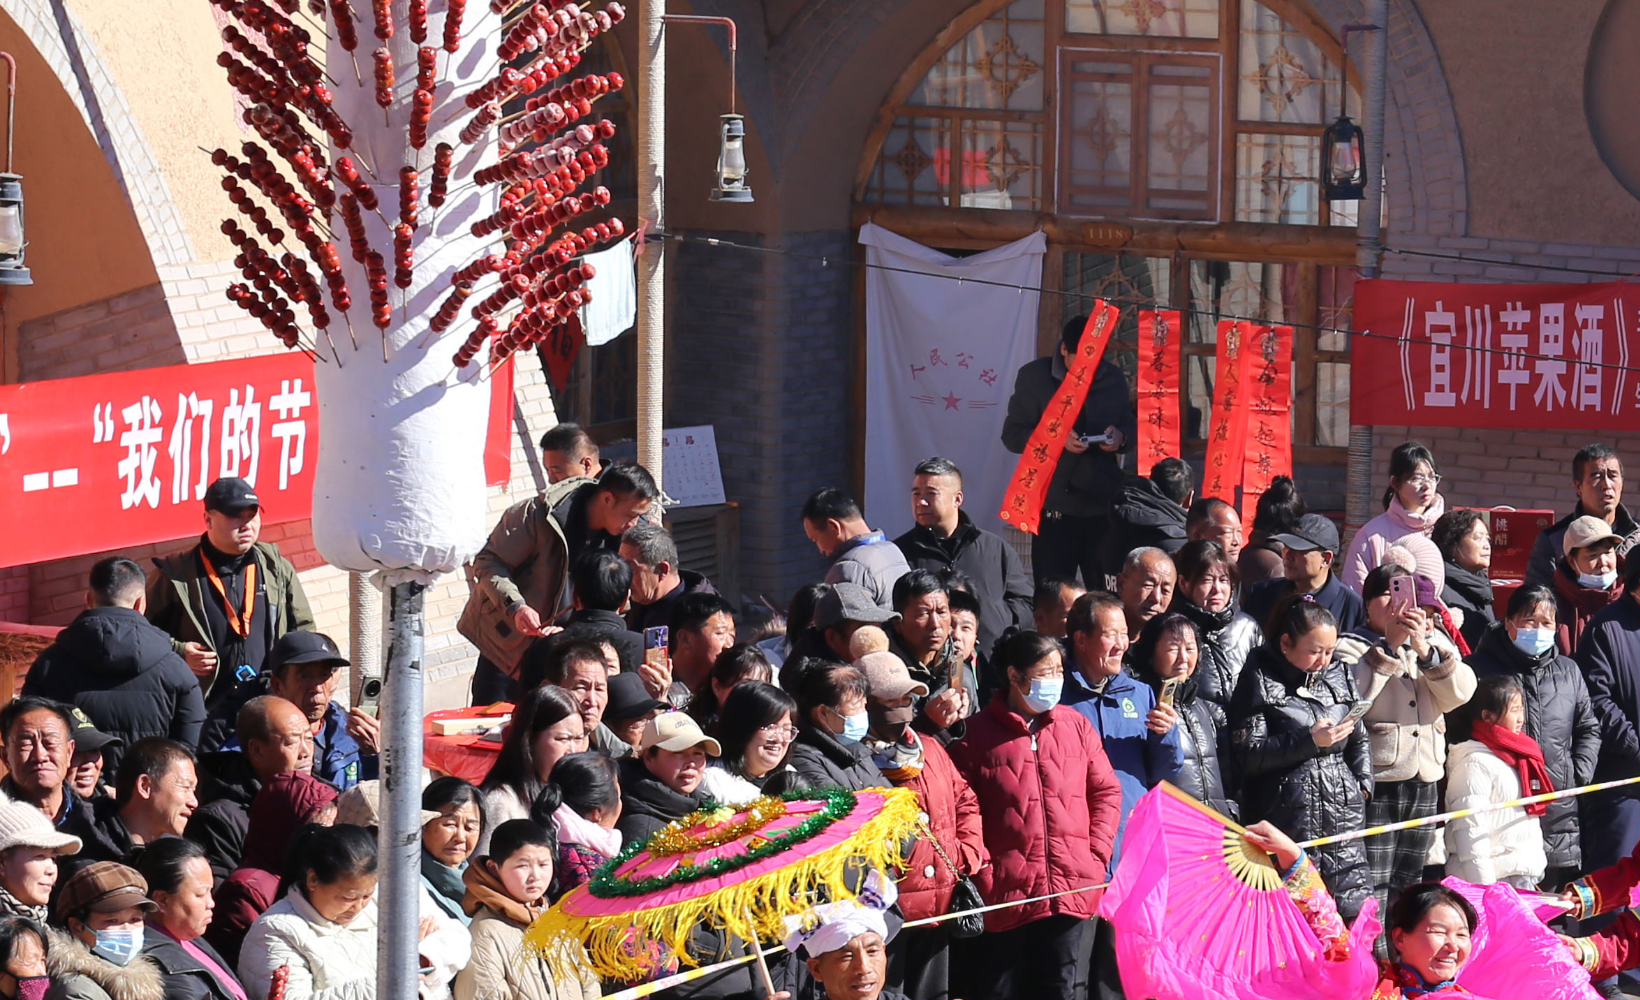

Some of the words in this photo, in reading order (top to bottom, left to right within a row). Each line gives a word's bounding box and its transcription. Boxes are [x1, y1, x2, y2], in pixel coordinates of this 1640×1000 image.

[1088, 228, 1124, 239] 1118
[1400, 297, 1629, 416] 《宜川苹果酒》
